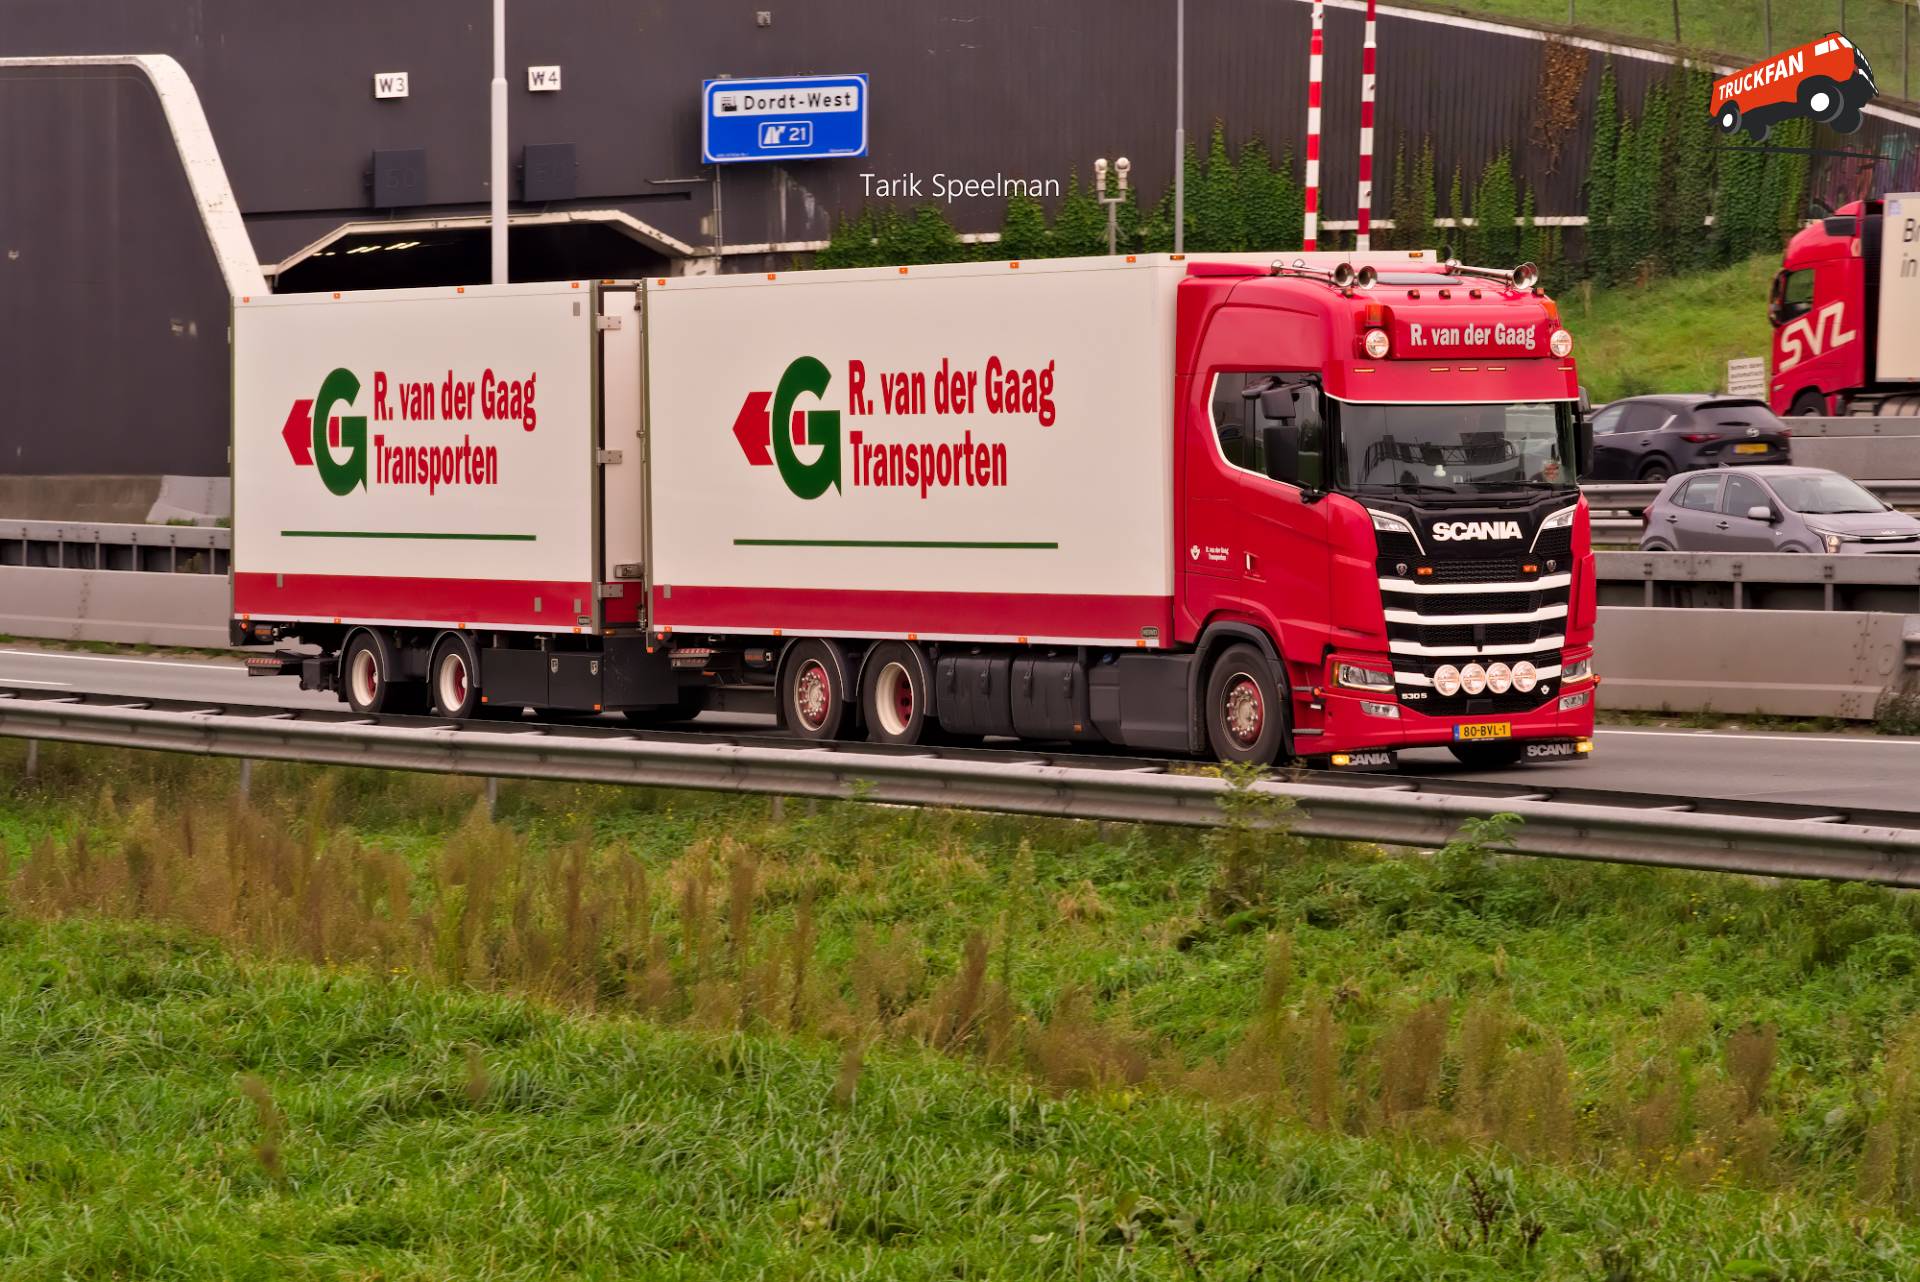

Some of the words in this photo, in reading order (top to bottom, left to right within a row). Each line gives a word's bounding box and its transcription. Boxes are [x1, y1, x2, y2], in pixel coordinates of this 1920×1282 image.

[744, 92, 851, 110] Dordt-West
[788, 127, 807, 141] 21
[1411, 324, 1427, 346] R.
[1431, 328, 1460, 346] van
[1464, 322, 1491, 345] der
[1495, 322, 1536, 350] Gaag
[1779, 301, 1857, 374] SVZ
[373, 371, 394, 421] R.
[399, 383, 435, 421] van
[440, 369, 476, 421] der
[481, 368, 537, 432] Gaag
[848, 359, 874, 416] R.
[881, 373, 927, 416] van
[934, 357, 978, 416] der
[985, 355, 1056, 428] Gaag
[373, 434, 498, 496] Transporten
[849, 430, 1008, 500] Transporten
[1432, 521, 1523, 541] SCANIA
[1463, 724, 1506, 737] 80-BVL-1
[1347, 752, 1391, 766] CANIA
